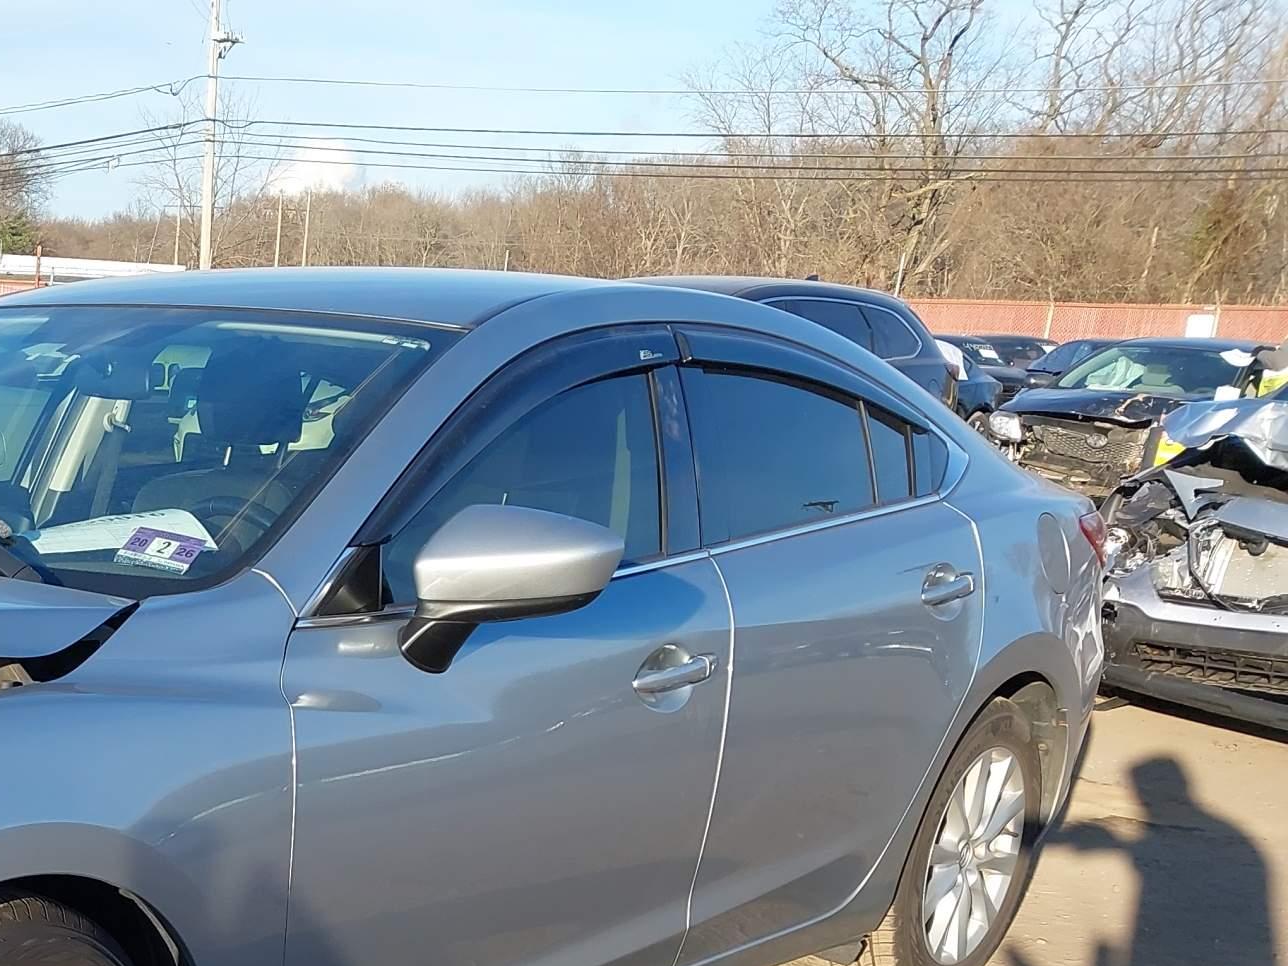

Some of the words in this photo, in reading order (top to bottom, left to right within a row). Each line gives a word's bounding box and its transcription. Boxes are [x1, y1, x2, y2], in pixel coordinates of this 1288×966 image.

[130, 537, 148, 548] 20
[156, 541, 172, 554] 2
[176, 547, 194, 558] 26
